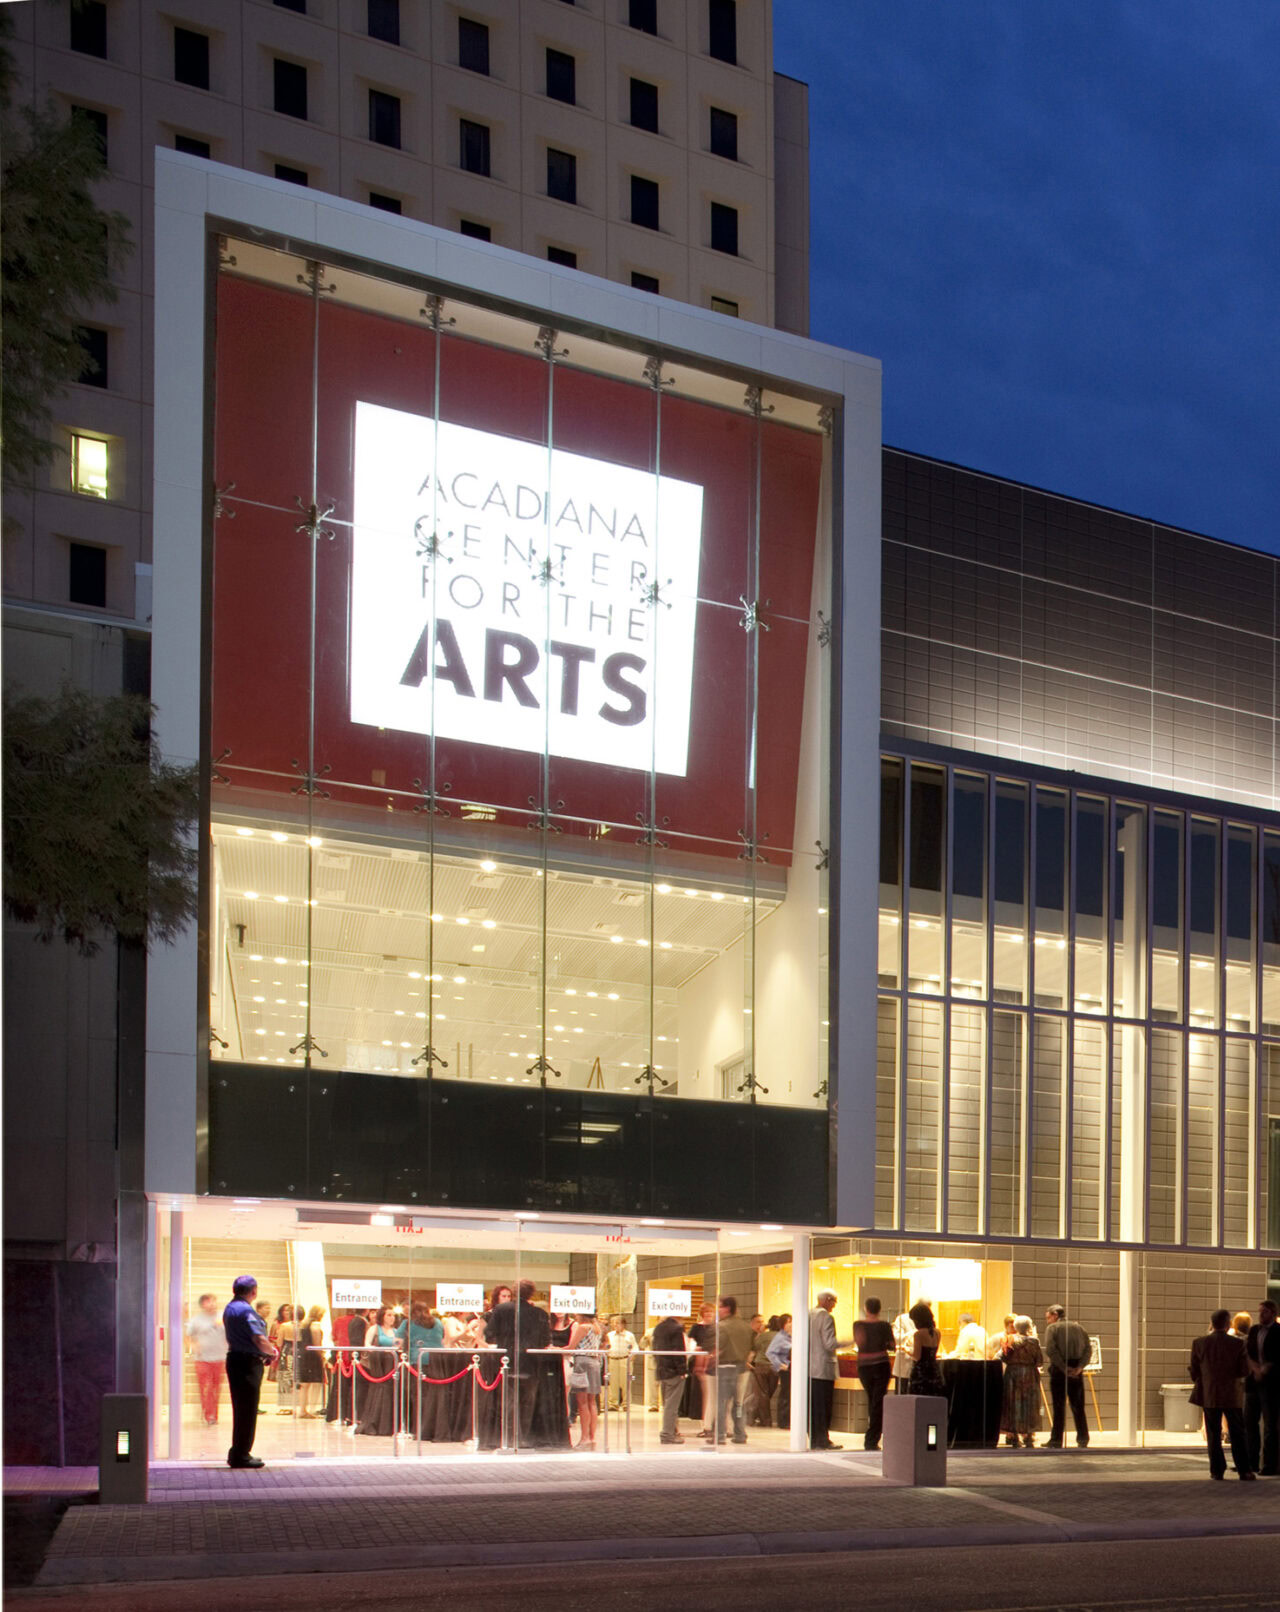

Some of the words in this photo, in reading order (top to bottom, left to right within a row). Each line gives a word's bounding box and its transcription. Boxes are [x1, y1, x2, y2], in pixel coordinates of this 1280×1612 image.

[417, 472, 649, 547] ACADIANA
[414, 514, 649, 594] CENTER
[557, 592, 646, 642] THE
[399, 617, 648, 727] ARTS
[335, 1292, 379, 1304] Entrance
[440, 1296, 481, 1307] Entrance
[553, 1297, 571, 1308] Exit
[572, 1298, 592, 1311] Only
[651, 1301, 669, 1311] Exit
[670, 1301, 689, 1313] Only
